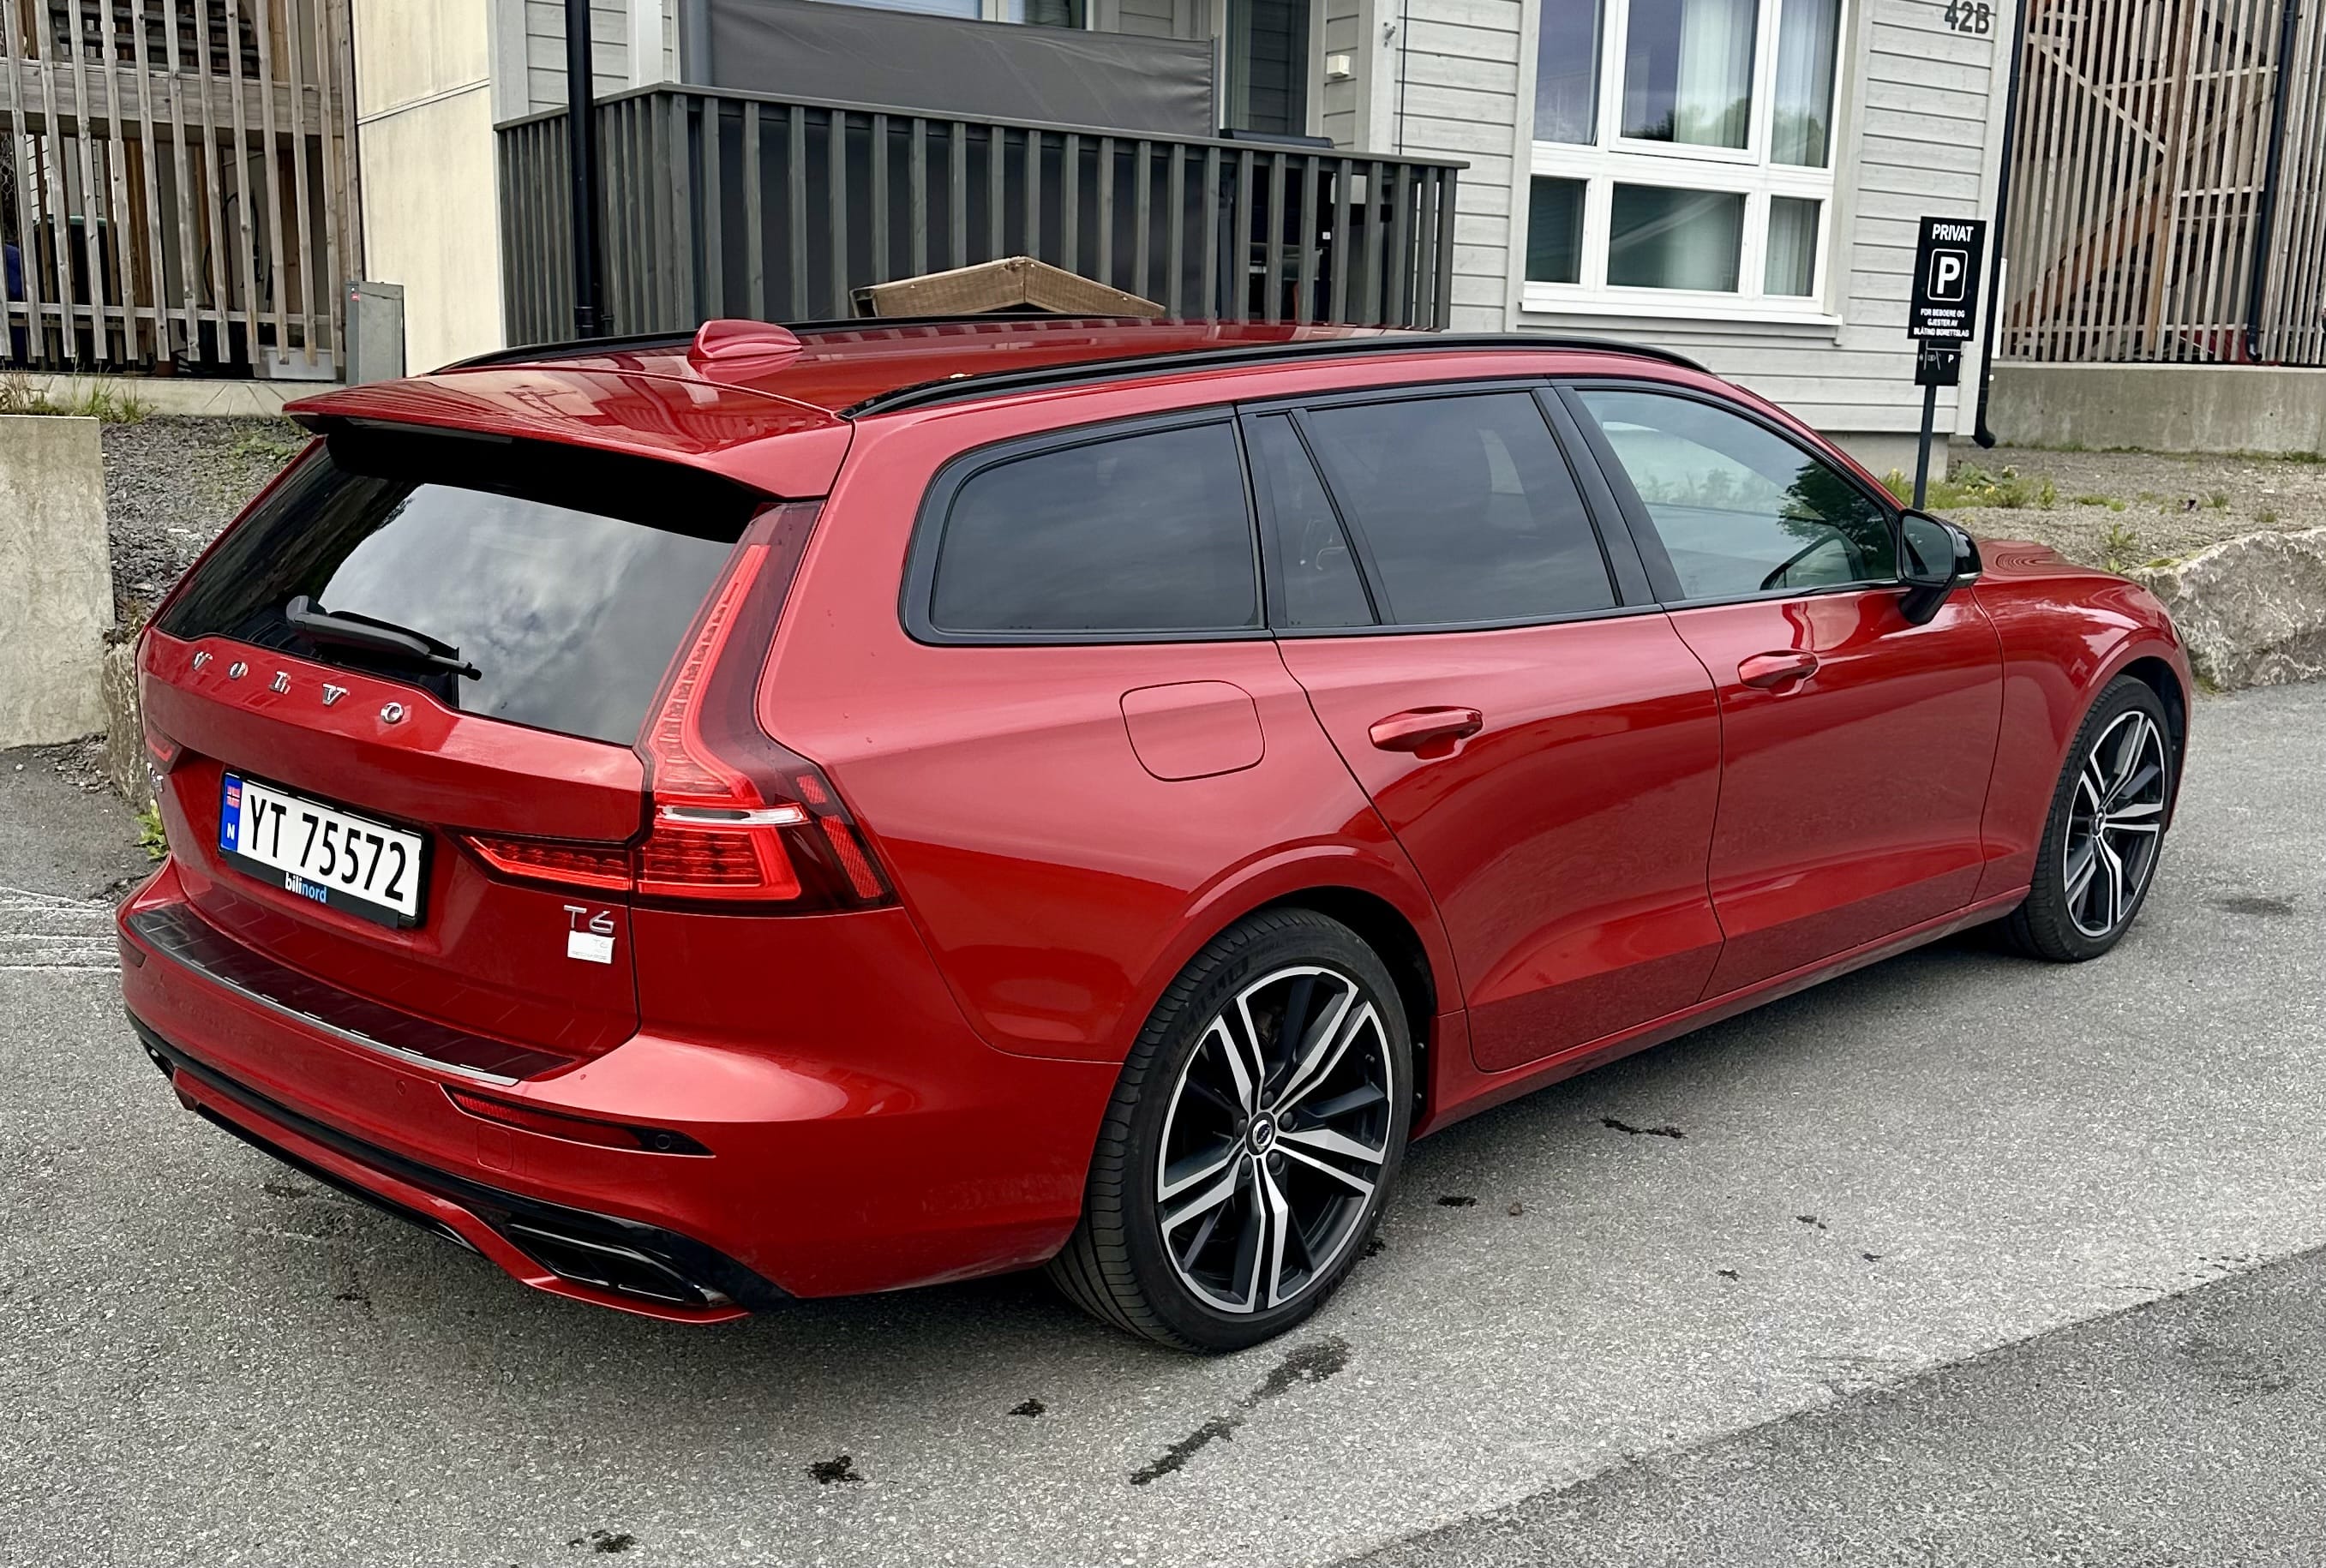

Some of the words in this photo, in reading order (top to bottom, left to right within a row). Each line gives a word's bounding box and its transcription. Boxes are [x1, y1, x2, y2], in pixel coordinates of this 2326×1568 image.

[1945, 0, 1989, 33] 42B
[1932, 224, 1974, 242] PRIVAT
[1937, 256, 1960, 294] P
[192, 650, 405, 724] VOLVO
[226, 823, 235, 840] N
[249, 794, 287, 859] YT
[300, 812, 406, 902] 75572
[285, 872, 327, 903] bilinord
[564, 905, 614, 934] T6
